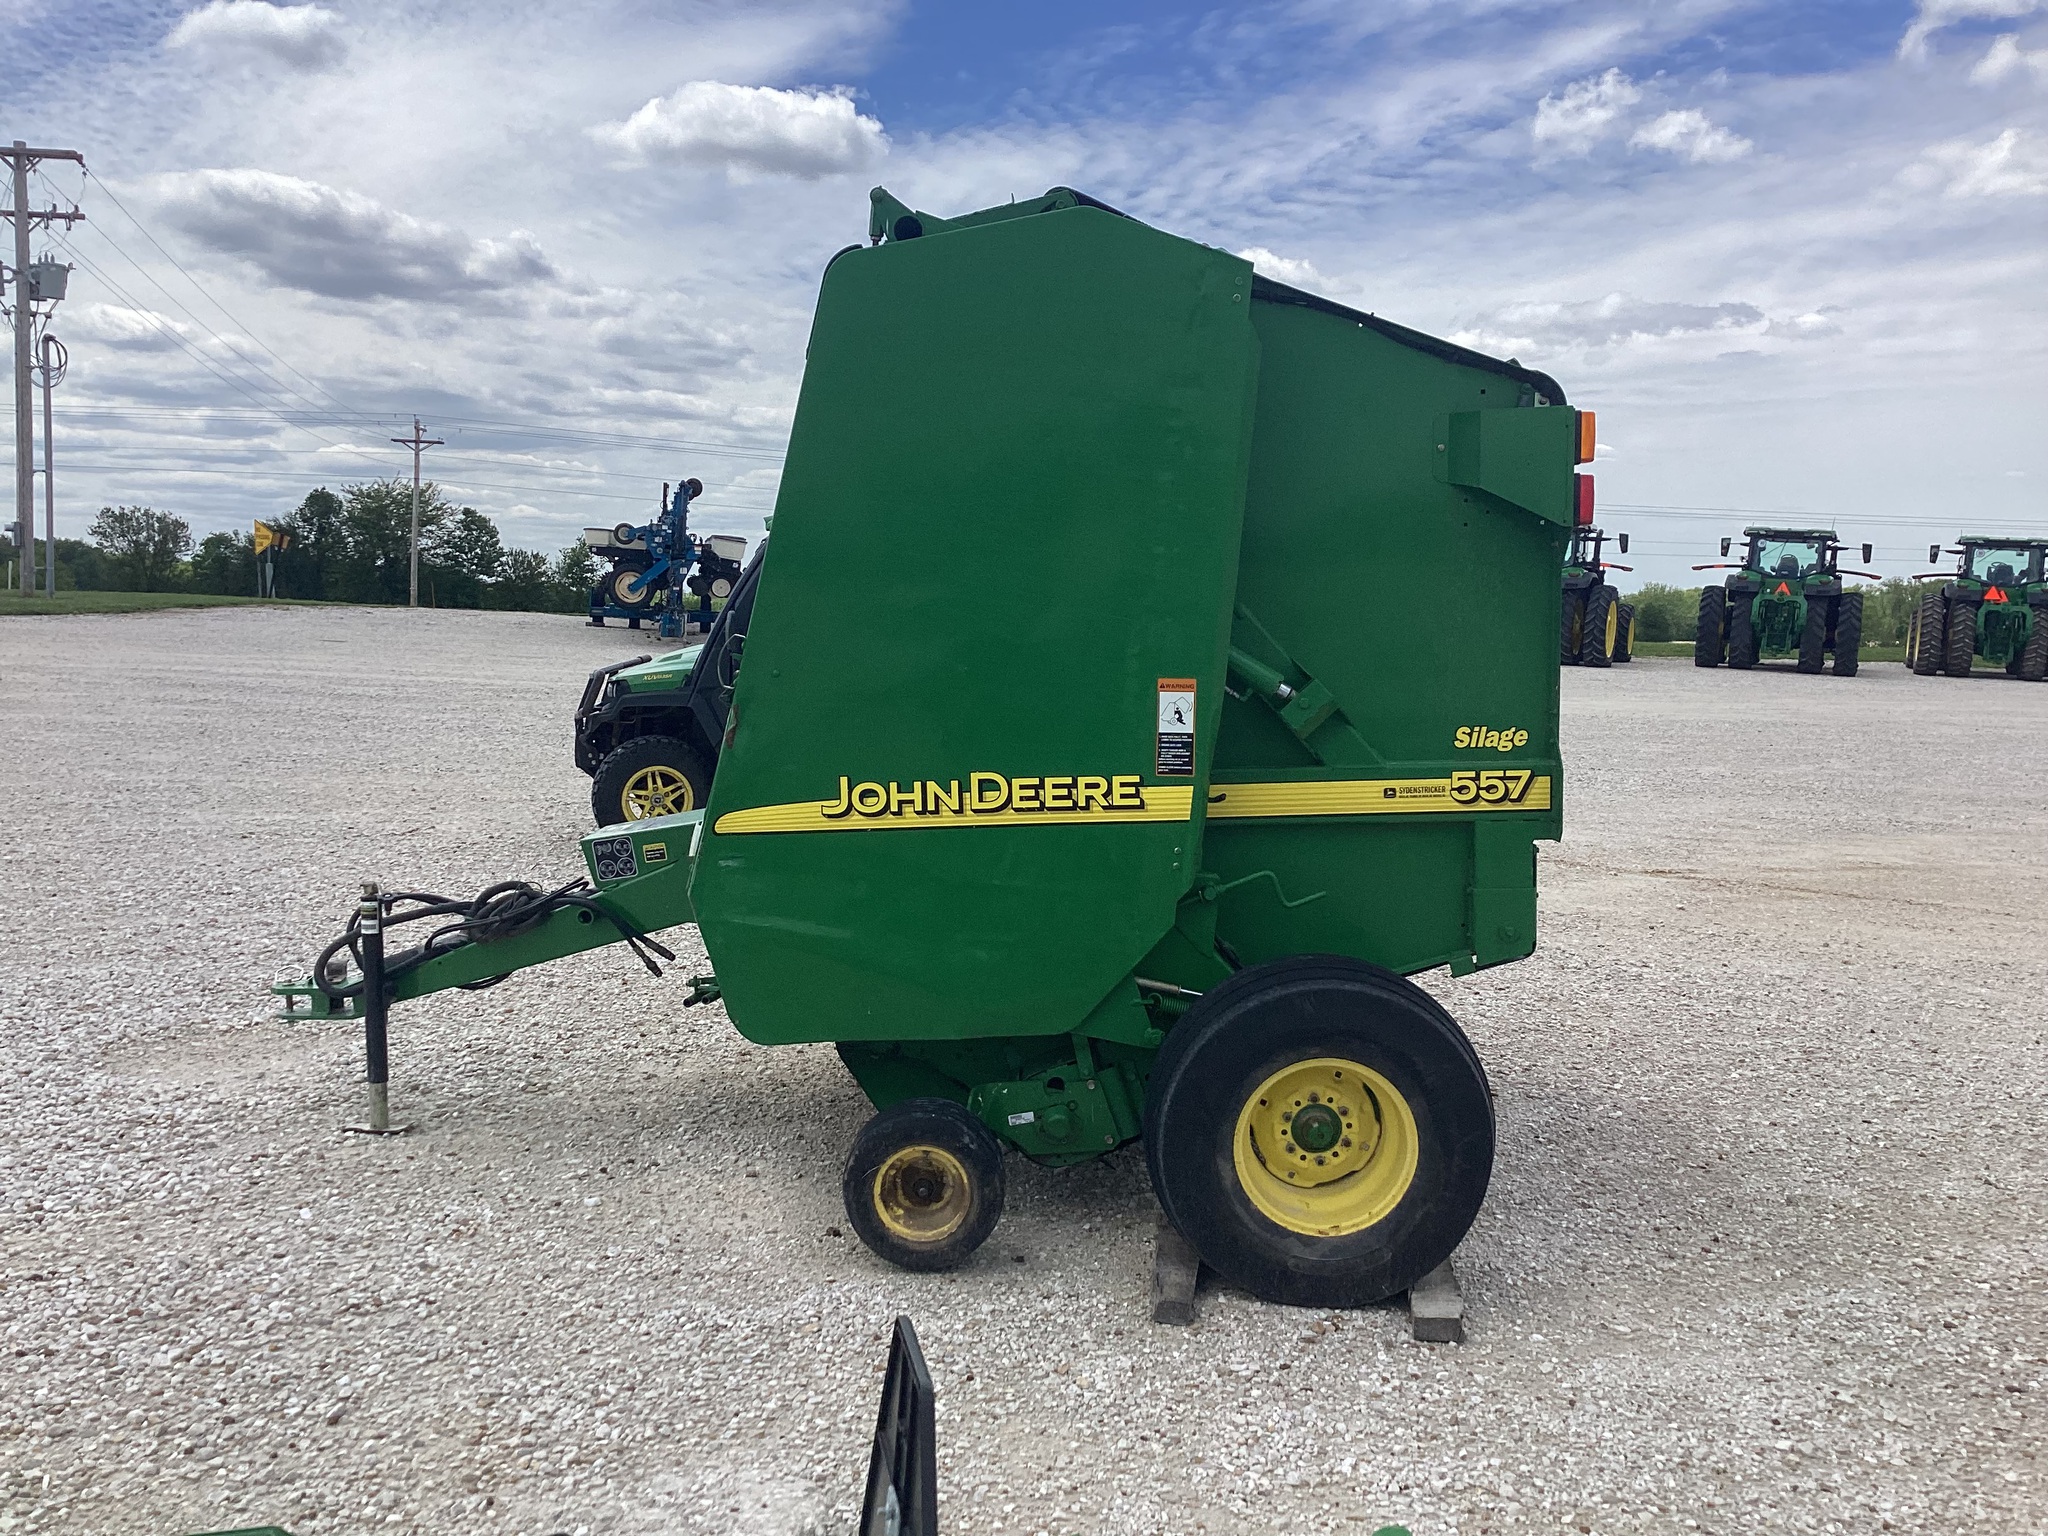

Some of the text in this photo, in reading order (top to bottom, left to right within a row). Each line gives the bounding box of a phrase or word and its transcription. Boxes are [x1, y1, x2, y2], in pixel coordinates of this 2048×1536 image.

[1453, 724, 1530, 752] Silage
[820, 771, 1146, 818] JOHN DEERE
[1399, 785, 1446, 794] SYDENSTRICKER
[1450, 769, 1537, 806] 557
